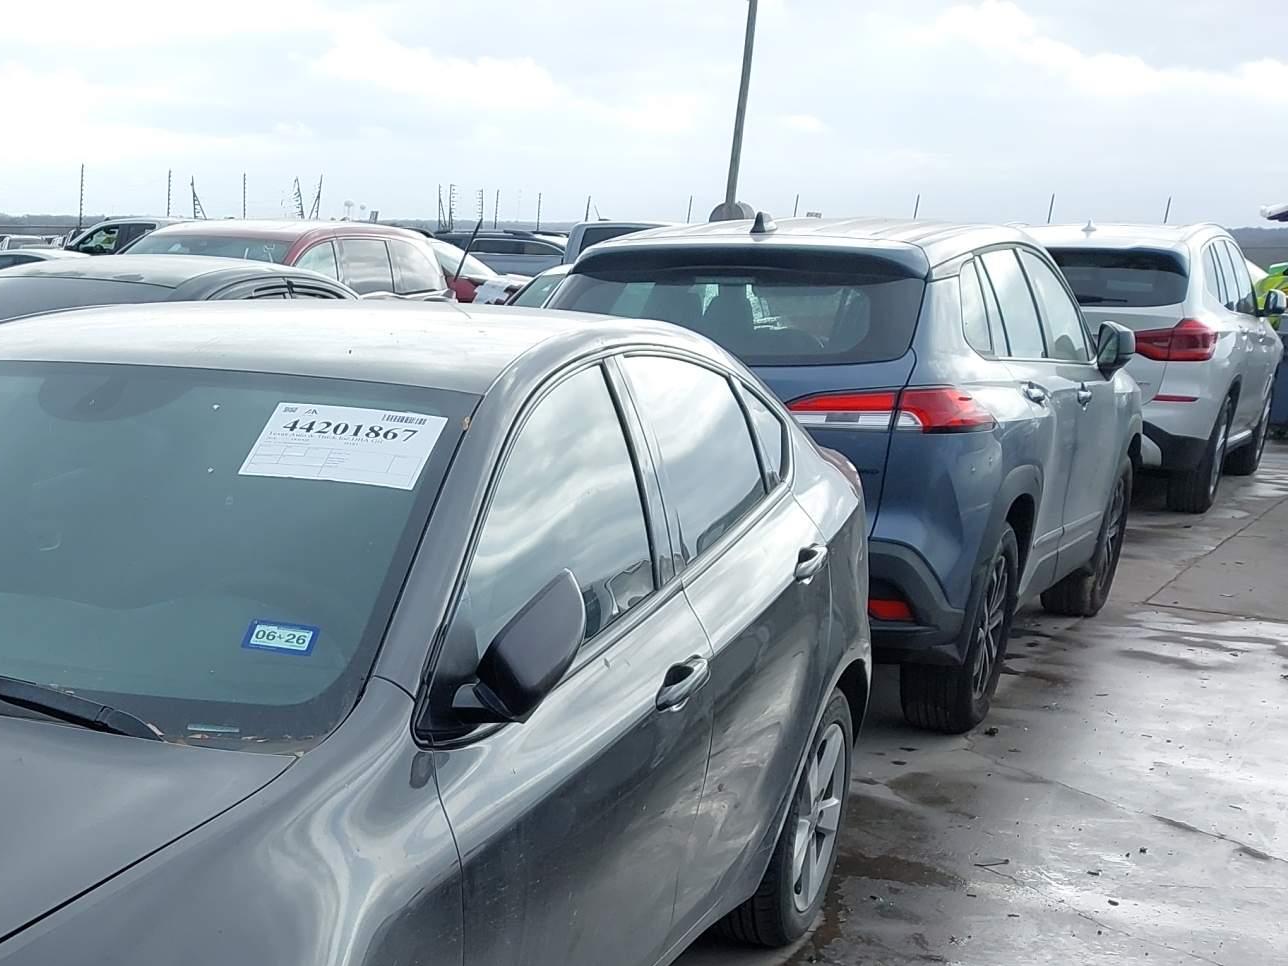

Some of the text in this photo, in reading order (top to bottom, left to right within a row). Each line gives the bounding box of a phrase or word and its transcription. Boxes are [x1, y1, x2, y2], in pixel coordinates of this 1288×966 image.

[283, 419, 418, 442] 44201867
[255, 630, 277, 641] 06
[285, 634, 307, 645] 26
